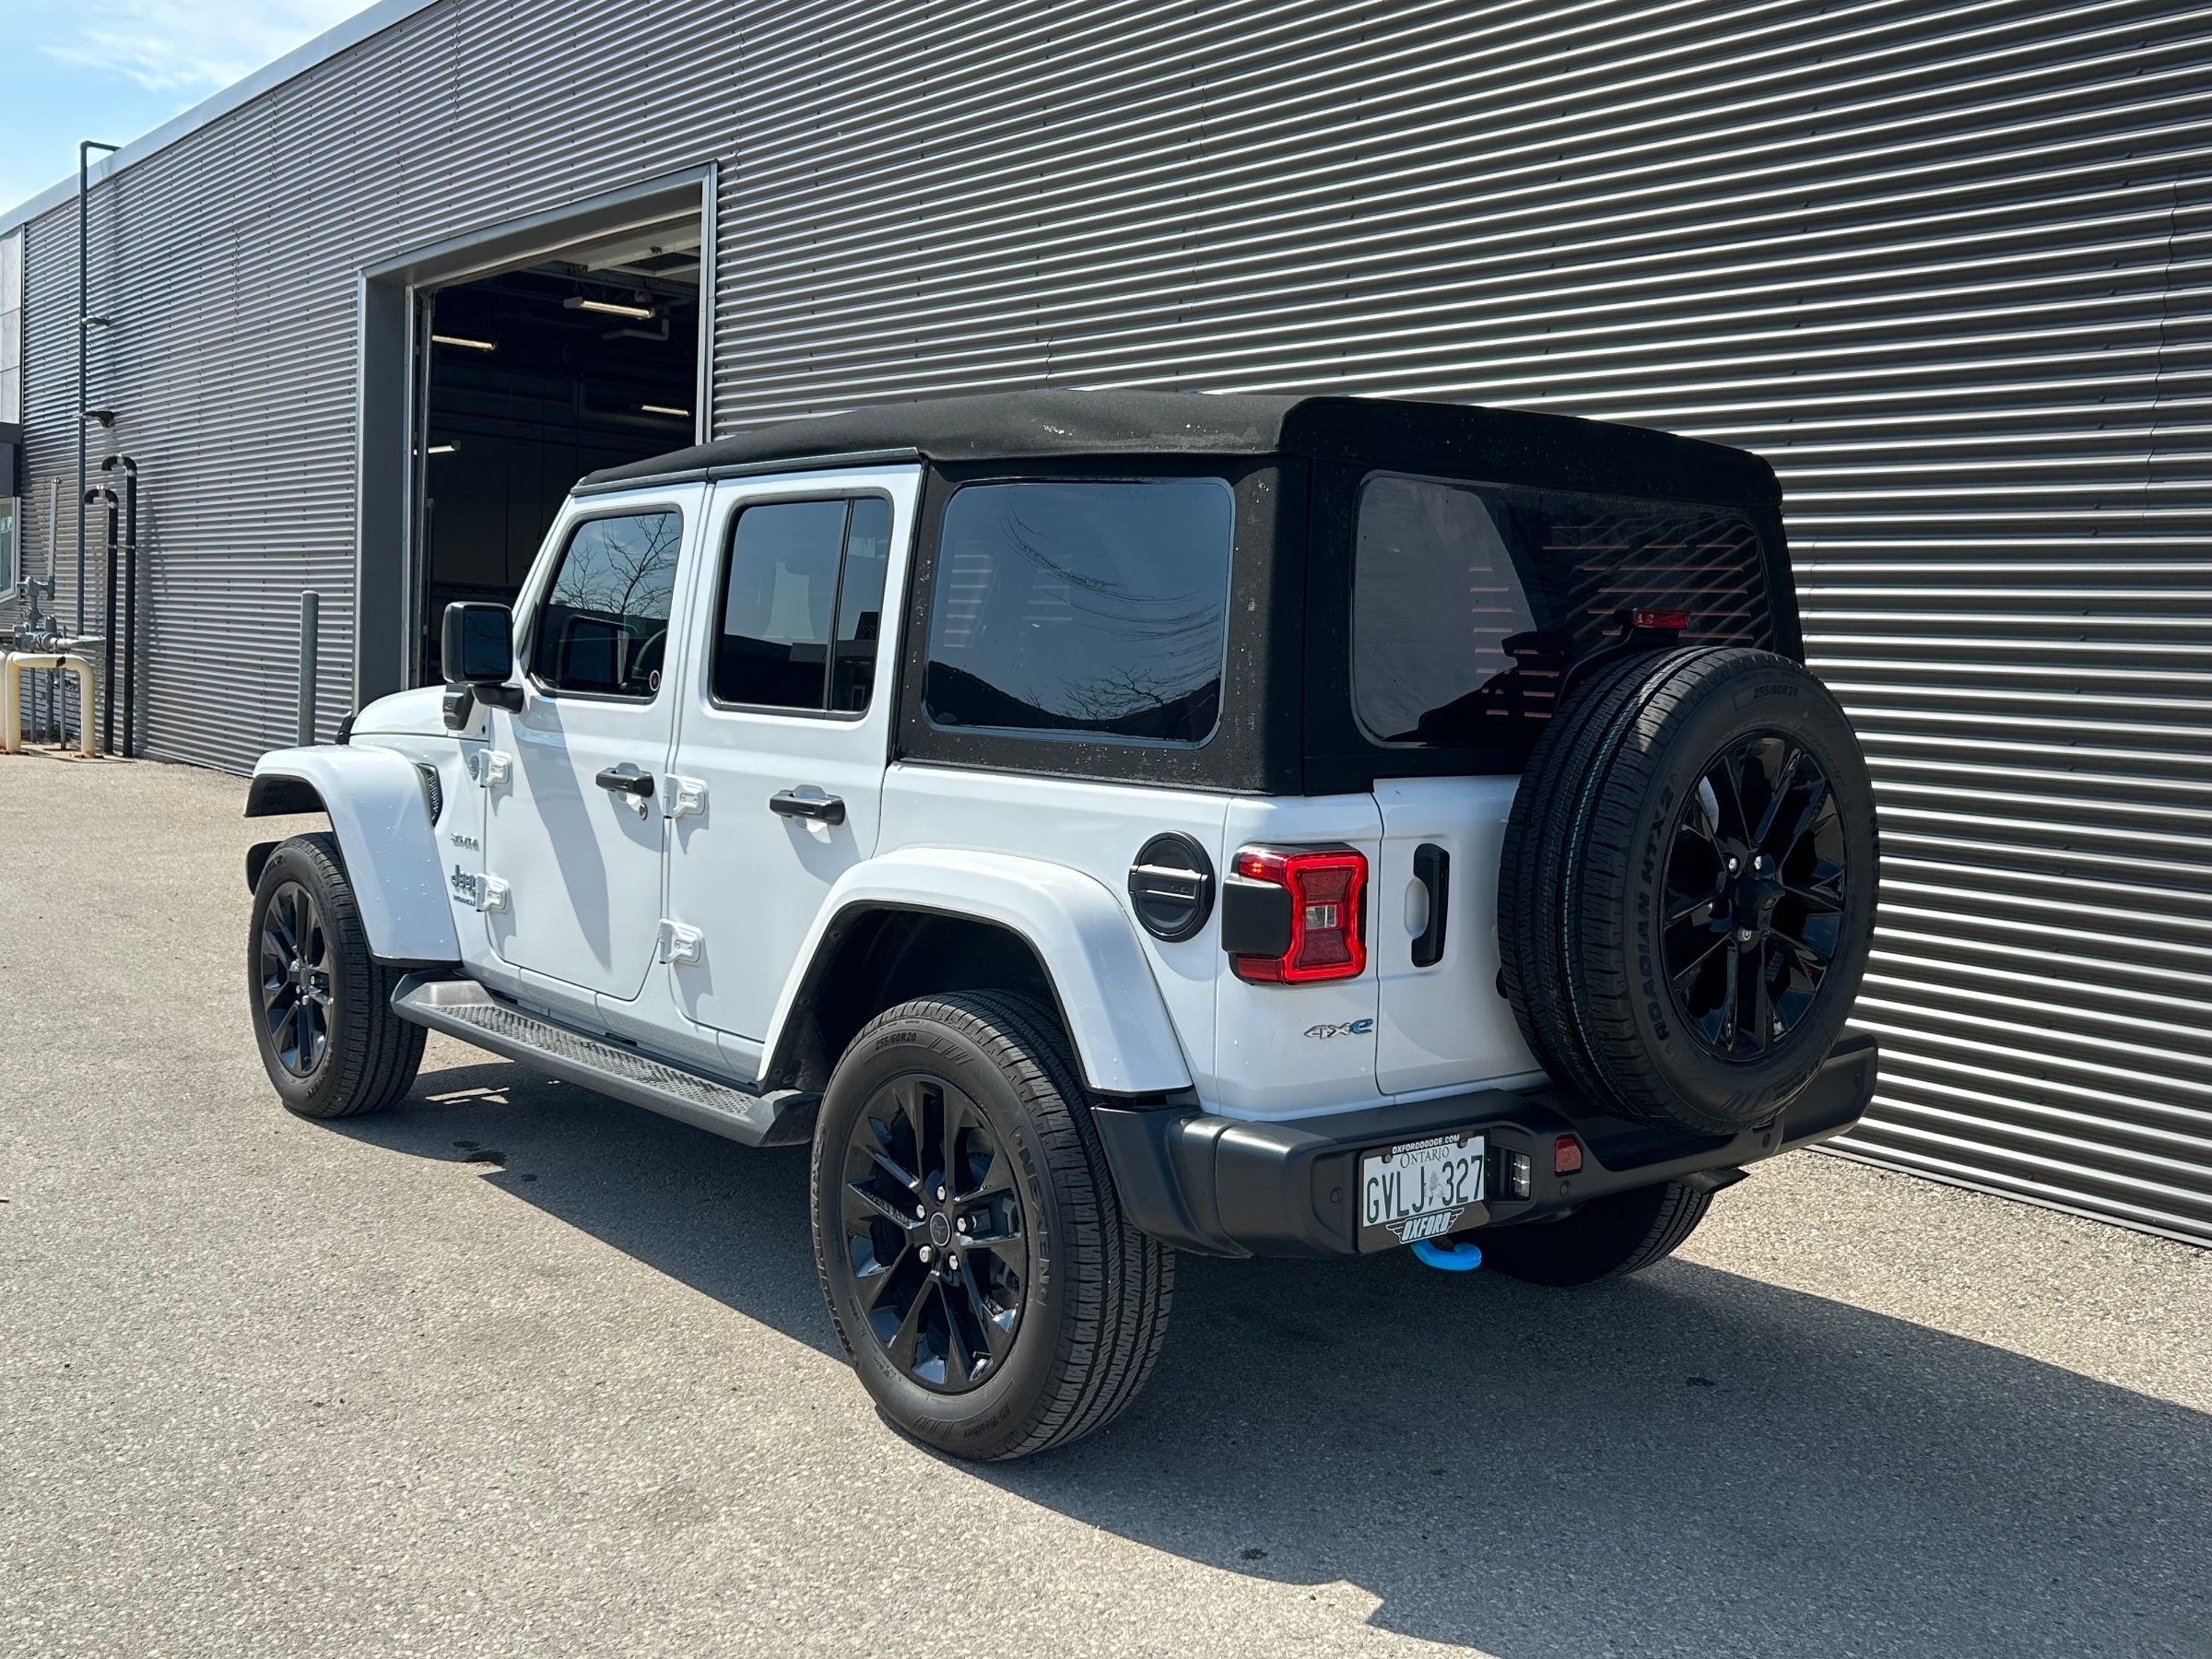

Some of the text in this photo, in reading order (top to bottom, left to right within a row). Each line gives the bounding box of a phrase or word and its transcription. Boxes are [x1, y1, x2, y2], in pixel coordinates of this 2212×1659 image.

[1753, 684, 1799, 700] 255/60R20
[1638, 785, 1675, 1041] ROADIAN HTX2
[875, 1032, 917, 1050] 255/60R20
[1392, 1134, 1460, 1154] OXFORDDODGE.COM
[1400, 1146, 1450, 1168] ONTARIO
[1366, 1155, 1483, 1224] GVLJ 327
[1018, 1147, 1051, 1285] NEXEN
[1402, 1211, 1452, 1241] OXFORD
[963, 1403, 1011, 1439] All-Weather
